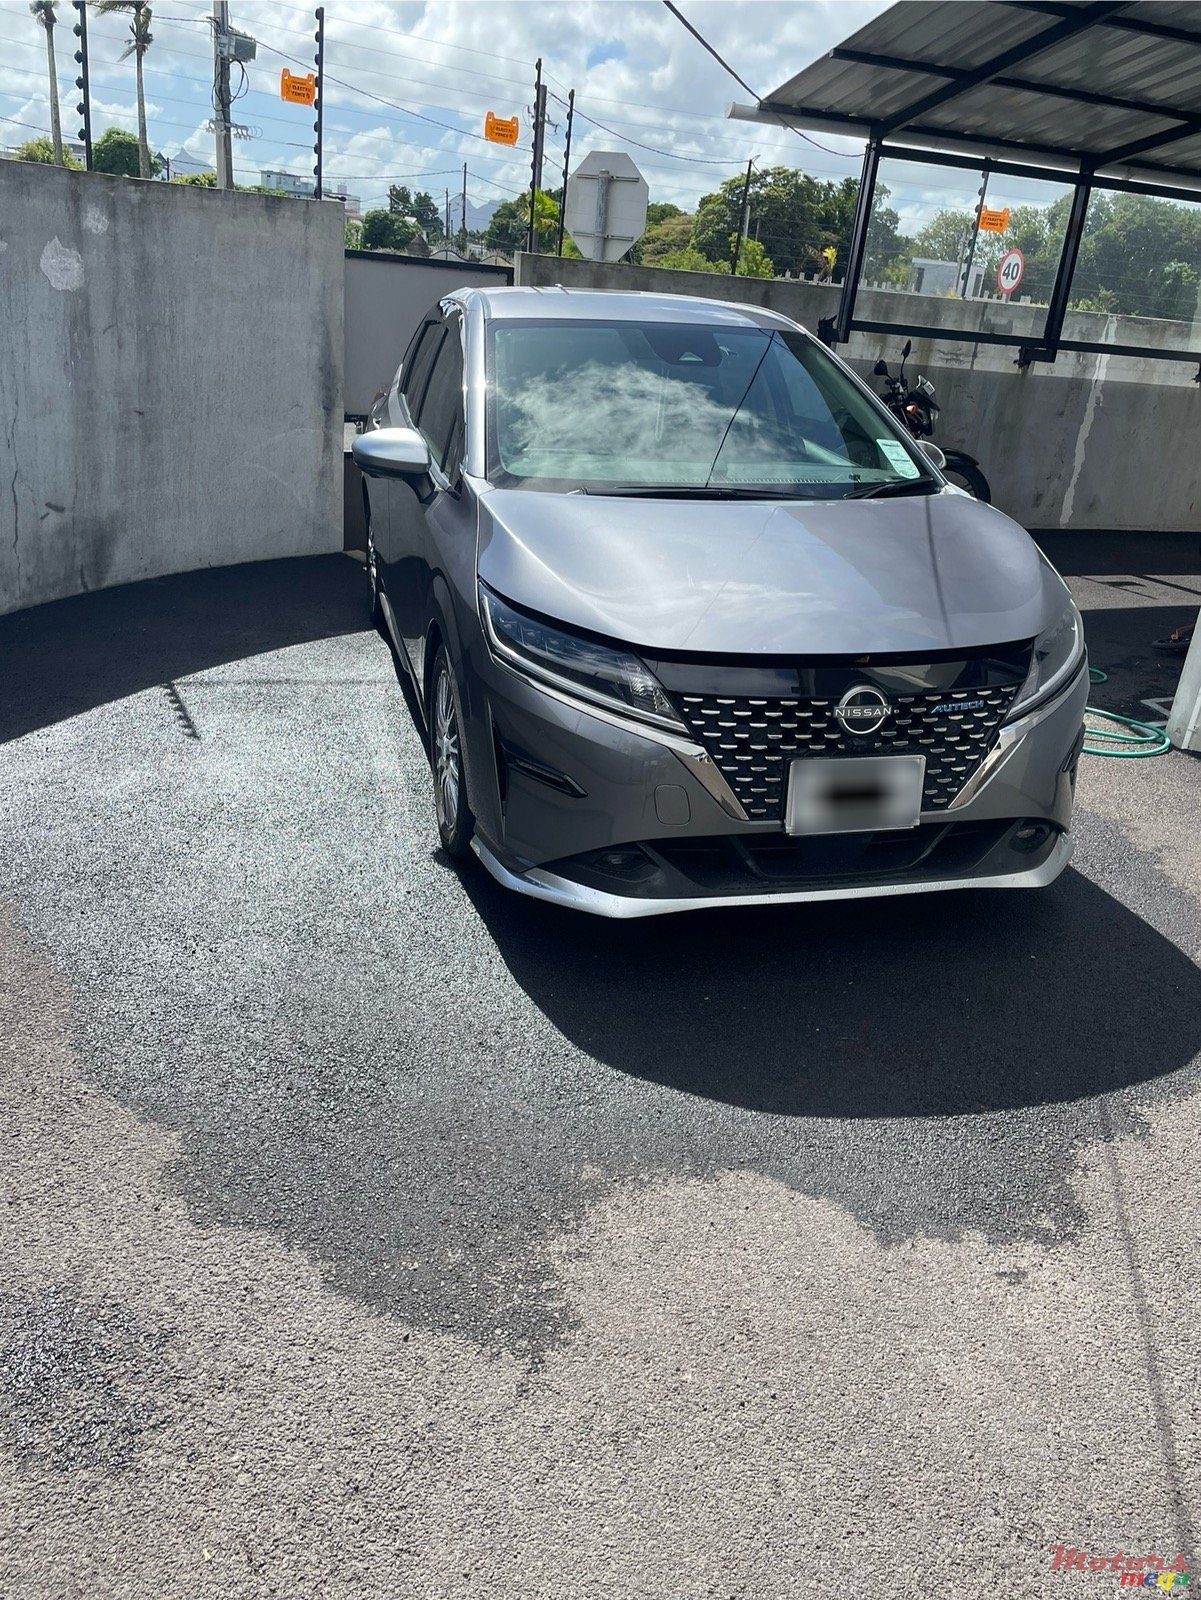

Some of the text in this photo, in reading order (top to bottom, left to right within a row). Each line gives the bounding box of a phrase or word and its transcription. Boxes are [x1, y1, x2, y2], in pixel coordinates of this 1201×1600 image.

[1002, 262, 1020, 280] 40
[835, 707, 892, 717] NISSAN
[931, 700, 985, 714] AUTECH
